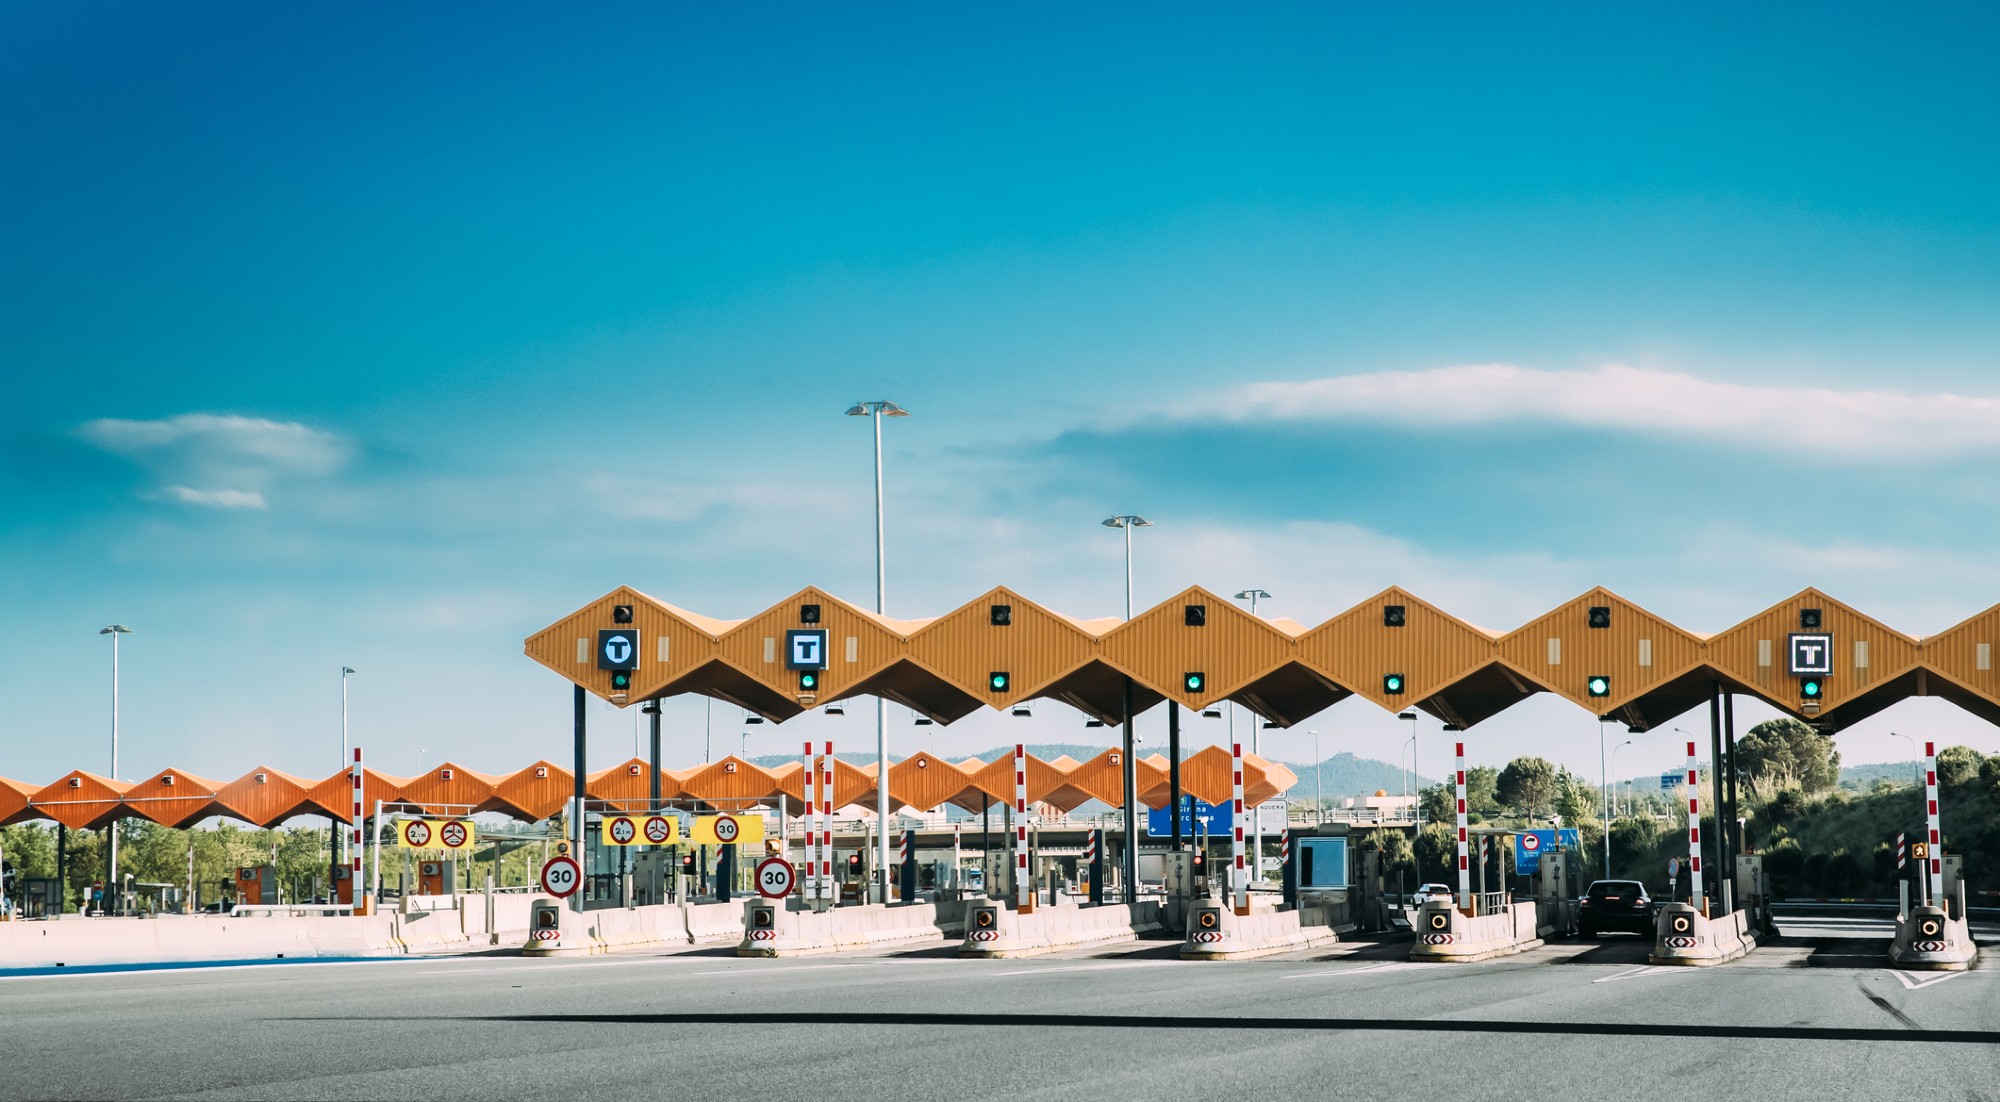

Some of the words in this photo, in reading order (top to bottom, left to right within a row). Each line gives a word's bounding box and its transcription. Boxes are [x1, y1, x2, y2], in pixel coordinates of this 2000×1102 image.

[609, 642, 628, 659] T
[797, 642, 816, 659] T
[1800, 646, 1822, 665] T
[719, 825, 734, 834] 30
[551, 870, 572, 883] 30
[764, 871, 786, 885] 30
